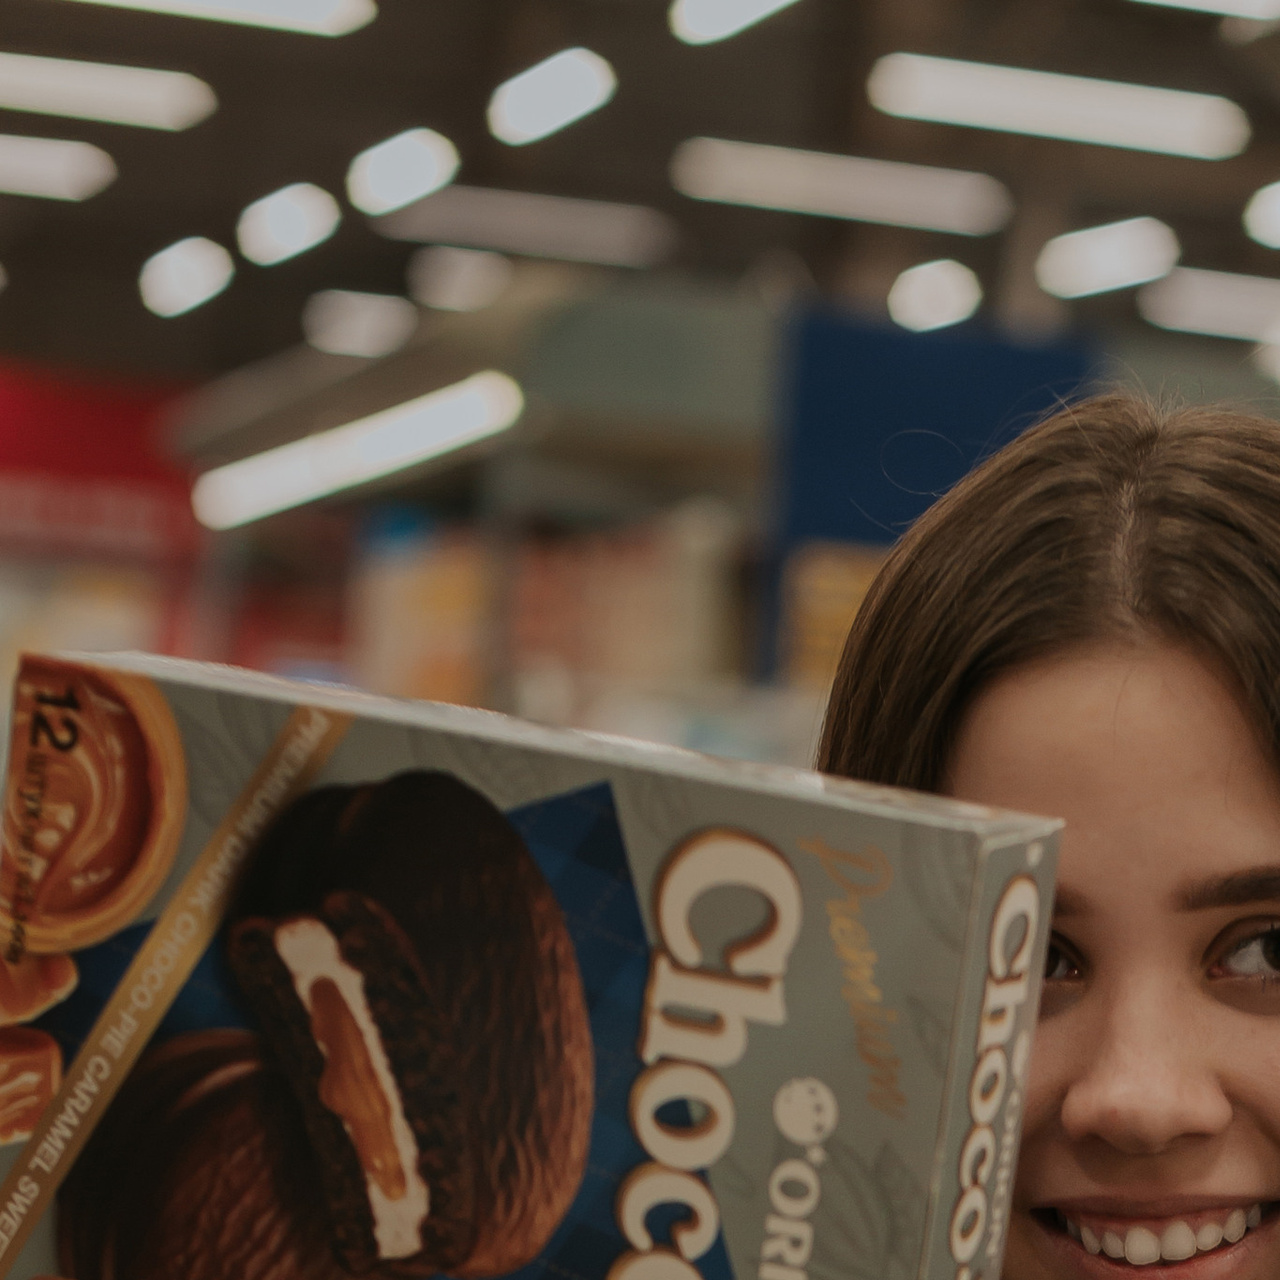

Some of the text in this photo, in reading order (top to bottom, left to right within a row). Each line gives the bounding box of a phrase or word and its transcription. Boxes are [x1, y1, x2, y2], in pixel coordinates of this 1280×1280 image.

[29, 687, 80, 752] 12
[234, 710, 330, 839] PREMIUM
[190, 834, 249, 920] DARK
[101, 914, 199, 1056] CHOCO-PIE
[28, 1051, 113, 1175] CARAMEL
